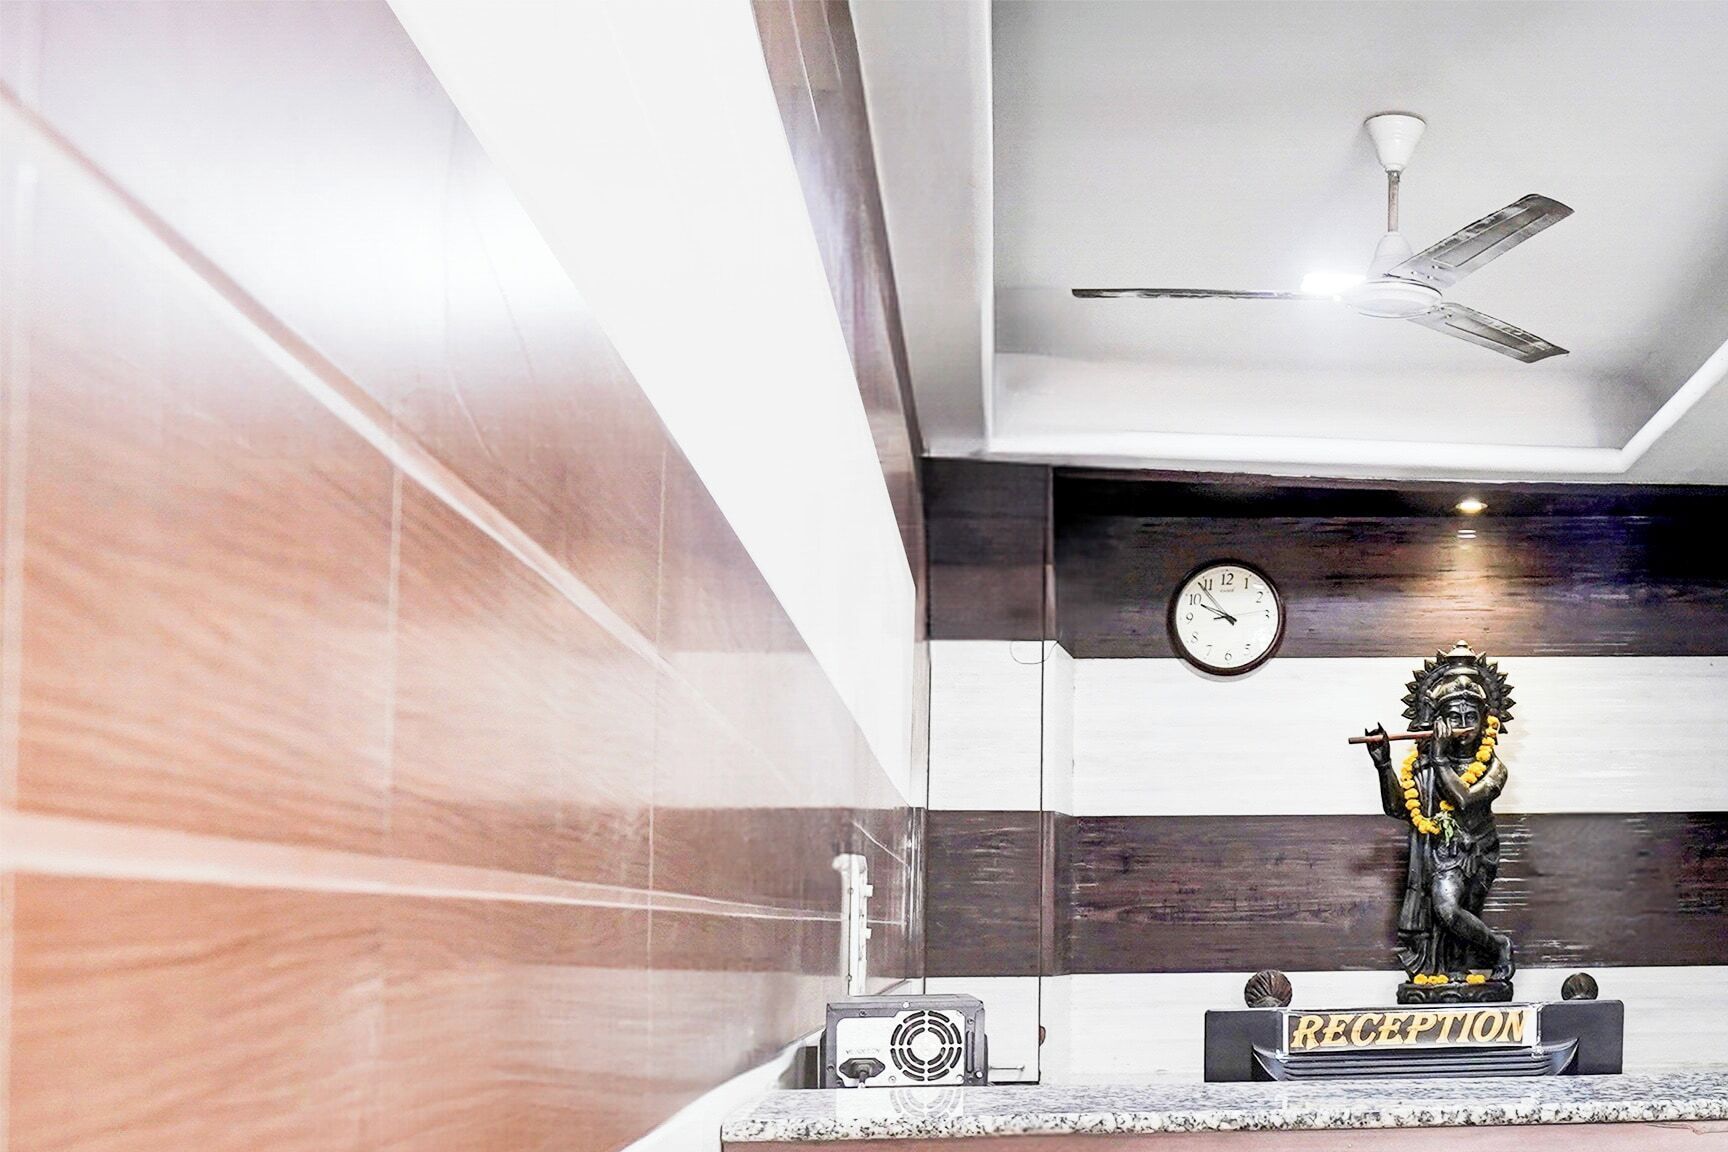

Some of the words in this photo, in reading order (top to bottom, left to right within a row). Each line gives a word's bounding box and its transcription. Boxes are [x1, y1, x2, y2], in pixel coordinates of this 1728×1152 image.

[1204, 578, 1213, 591] 11
[1221, 573, 1234, 586] 12
[1244, 577, 1249, 590] 1
[1189, 593, 1202, 606] 10
[1255, 591, 1264, 604] 2
[1290, 1010, 1527, 1050] RECEPTION
